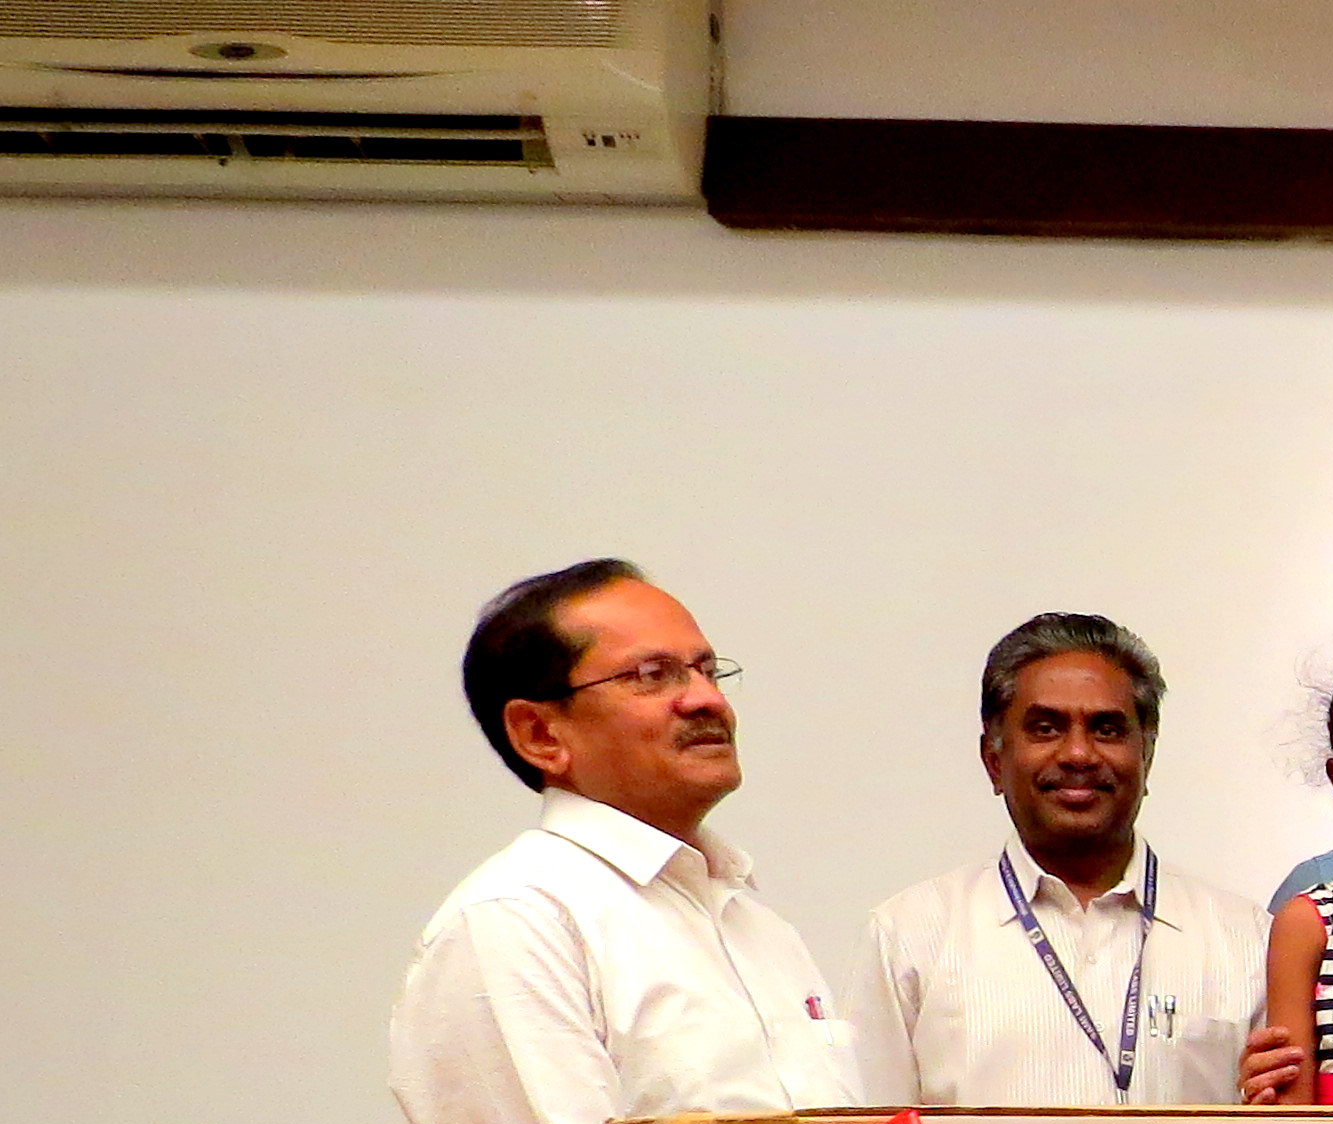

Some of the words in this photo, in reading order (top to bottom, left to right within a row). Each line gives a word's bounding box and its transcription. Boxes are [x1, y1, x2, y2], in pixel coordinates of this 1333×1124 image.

[1044, 954, 1068, 990] LIMITED
[1066, 990, 1083, 1015] LABS
[1126, 996, 1137, 1036] LIMITED
